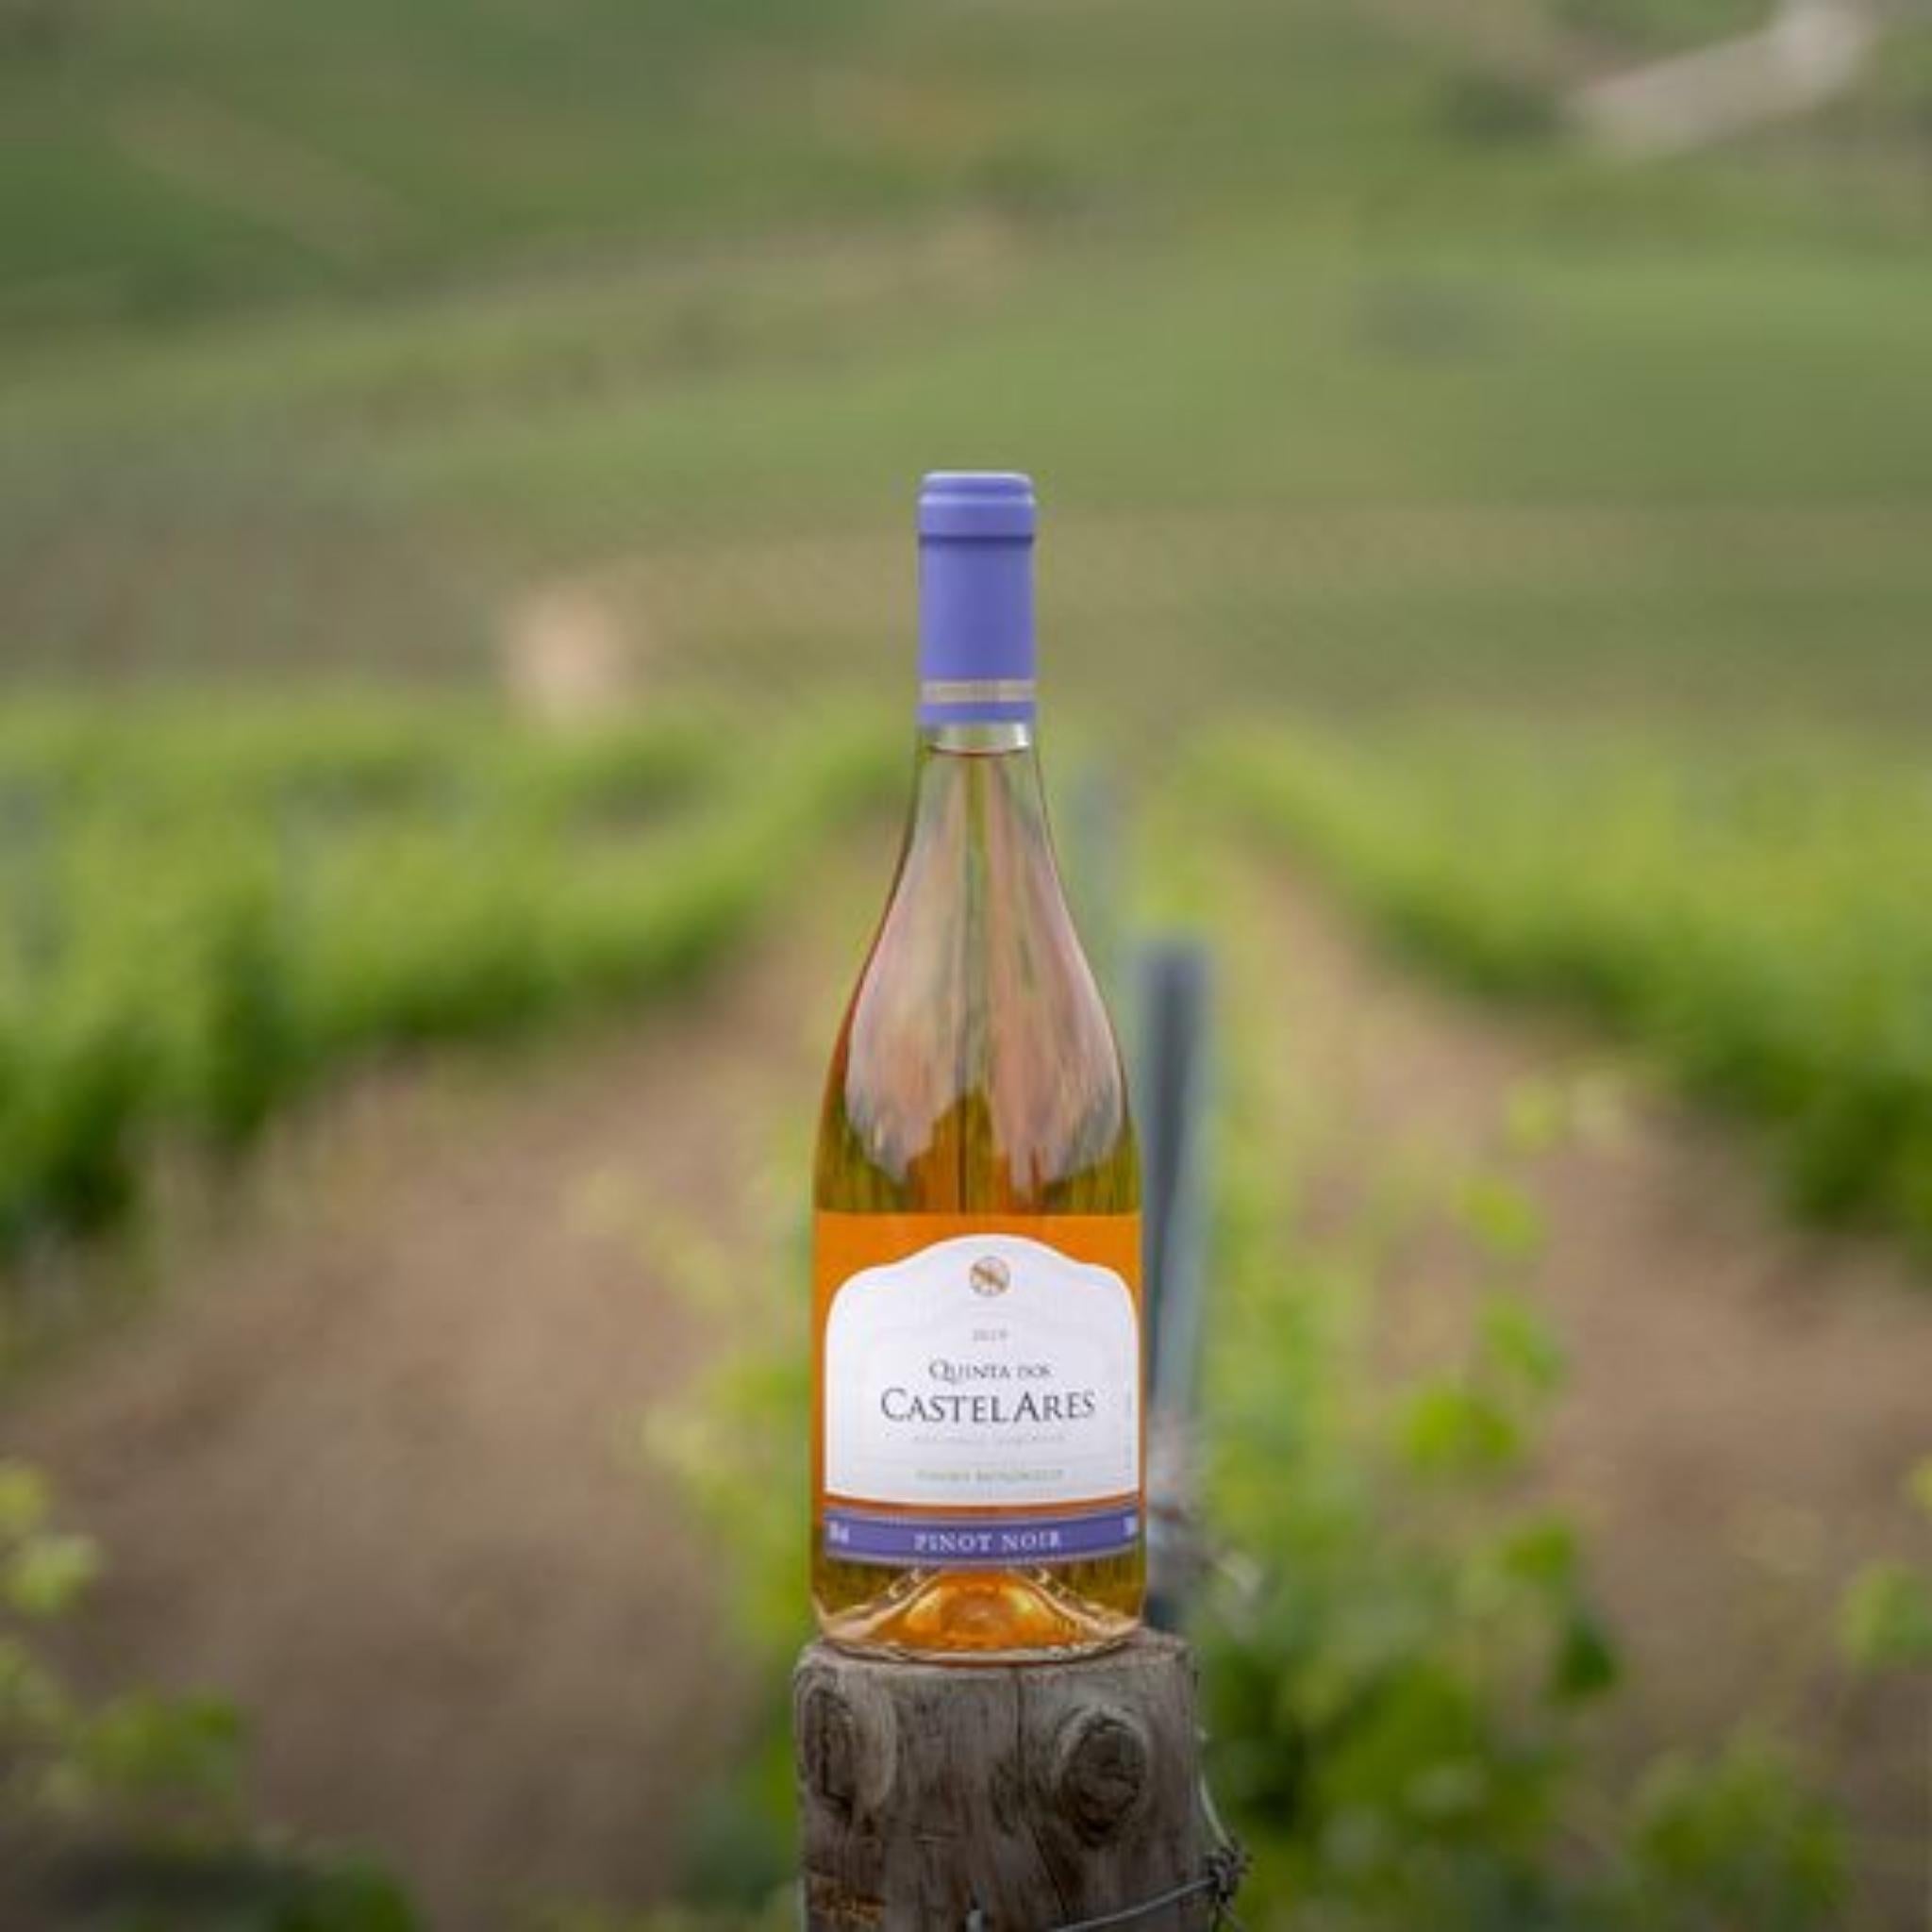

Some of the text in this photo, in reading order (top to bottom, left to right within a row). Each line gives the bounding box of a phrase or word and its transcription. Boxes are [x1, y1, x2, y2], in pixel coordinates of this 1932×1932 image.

[928, 1359, 1011, 1384] QUINTA
[913, 1529, 1062, 1552] PINOT NOIR
